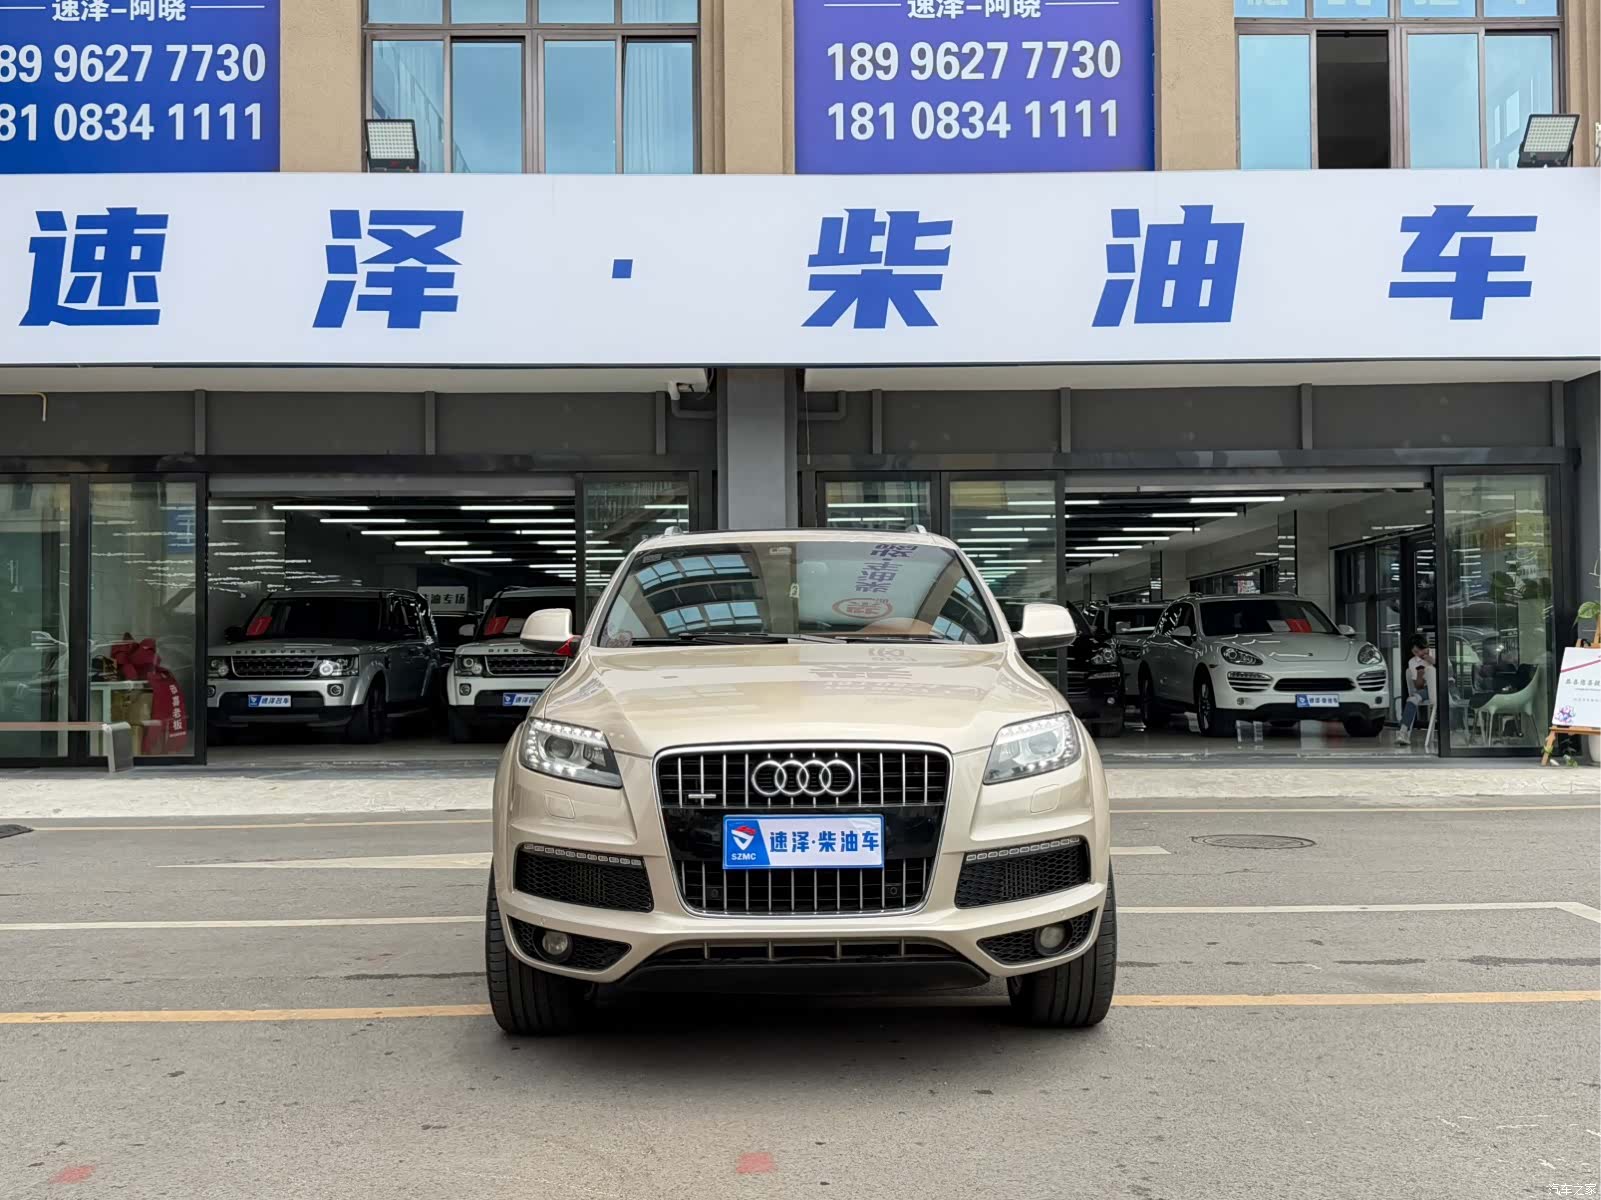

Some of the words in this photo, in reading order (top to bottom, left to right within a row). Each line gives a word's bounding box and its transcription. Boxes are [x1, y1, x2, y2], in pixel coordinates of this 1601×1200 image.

[54, 44, 153, 83] 9627
[166, 43, 266, 82] 7730
[827, 42, 899, 81] 189
[910, 41, 1009, 80] 9627
[1021, 40, 1121, 79] 7730
[54, 103, 155, 141] 0834
[168, 103, 261, 140] 1111
[828, 102, 895, 140] 181
[911, 101, 1011, 140] 0834
[1025, 99, 1117, 138] 1111
[731, 853, 757, 861] SZMC
[769, 830, 880, 853] 速泽·柴油车
